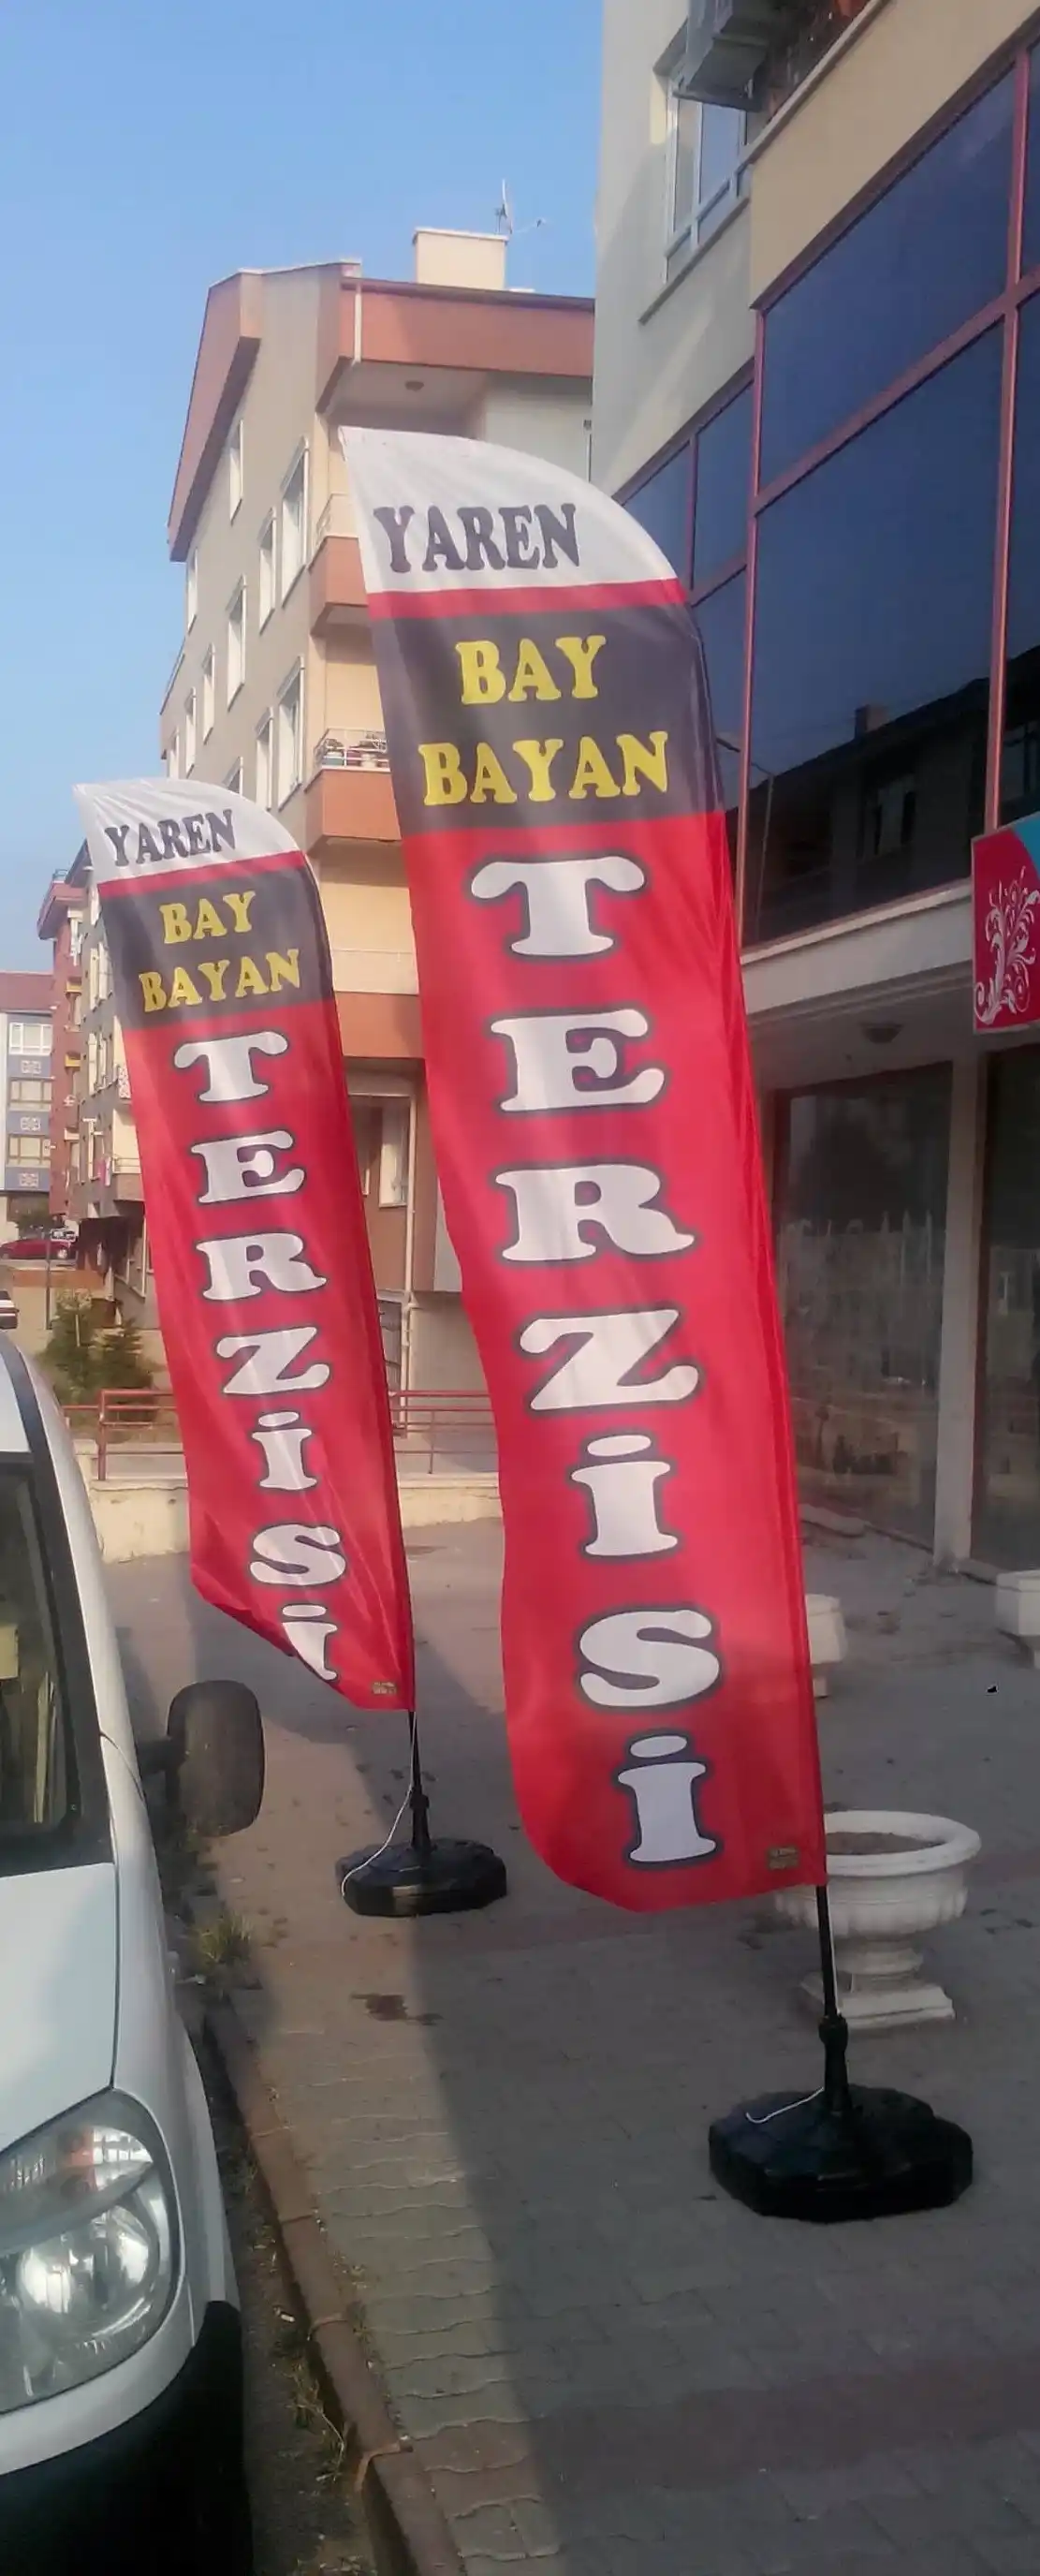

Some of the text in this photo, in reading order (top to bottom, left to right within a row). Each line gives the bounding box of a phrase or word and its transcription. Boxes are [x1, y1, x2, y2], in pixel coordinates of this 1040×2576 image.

[374, 503, 579, 572] YAREN
[456, 636, 606, 704] BAY
[418, 731, 668, 805] BAYAN
[105, 810, 236, 866] YAREN
[160, 891, 256, 944] BAY
[139, 949, 300, 1012] BAYAN
[469, 855, 721, 1864] TERZİSİ
